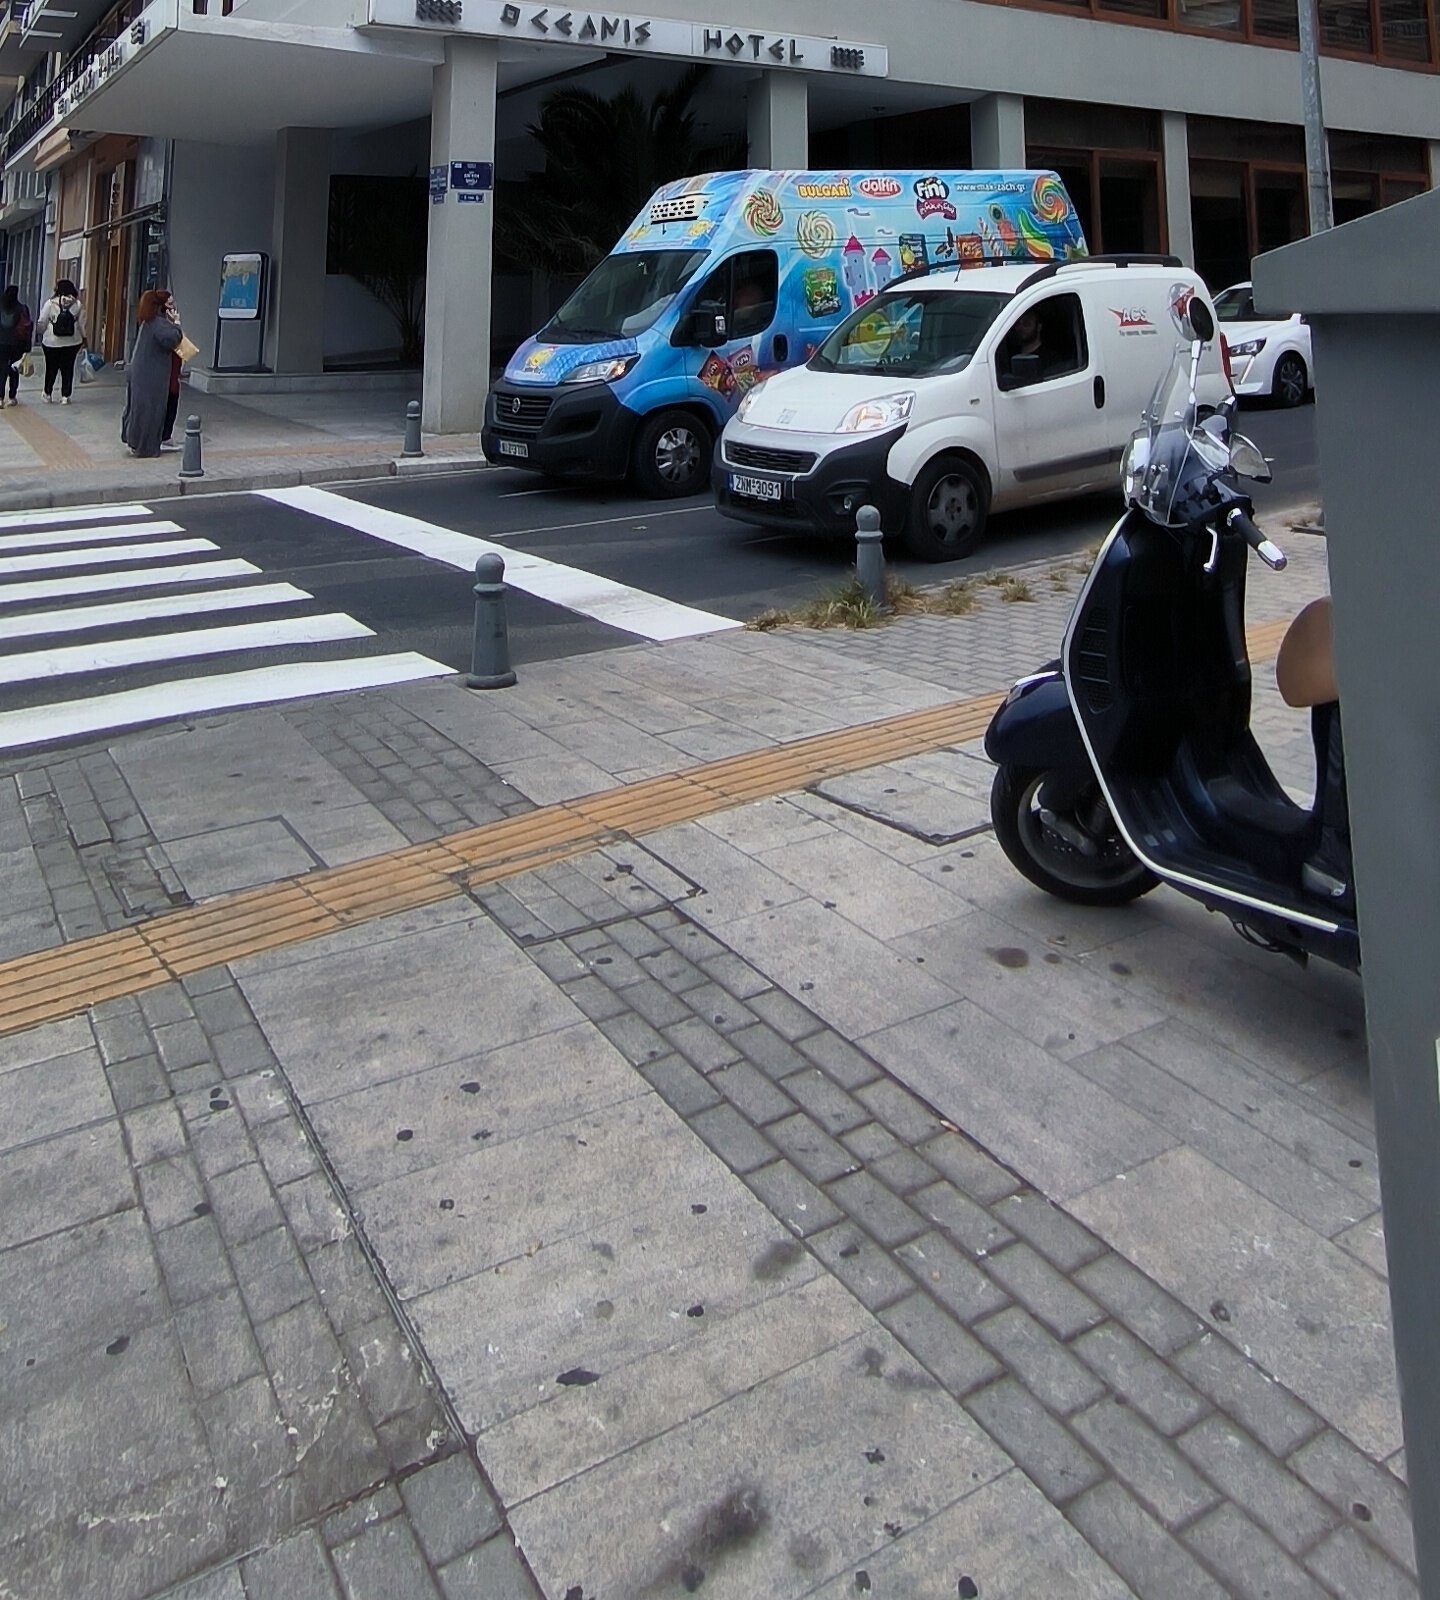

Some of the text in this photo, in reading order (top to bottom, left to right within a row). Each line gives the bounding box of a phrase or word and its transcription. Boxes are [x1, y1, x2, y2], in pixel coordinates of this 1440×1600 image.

[500, 2, 804, 64] OCEANIS HOTEL
[1121, 306, 1148, 322] ACS
